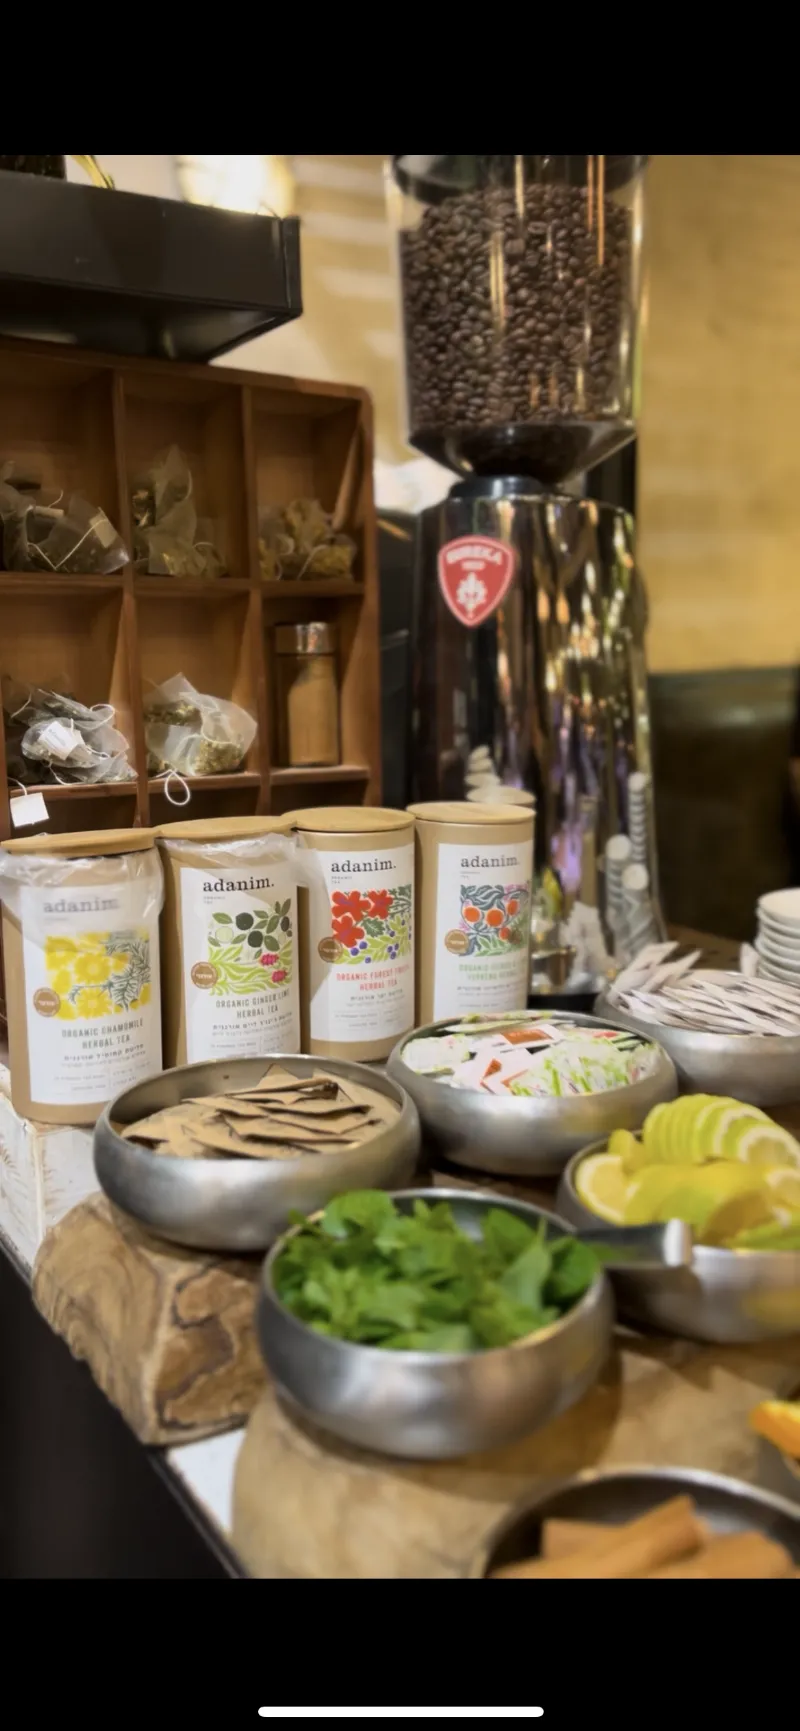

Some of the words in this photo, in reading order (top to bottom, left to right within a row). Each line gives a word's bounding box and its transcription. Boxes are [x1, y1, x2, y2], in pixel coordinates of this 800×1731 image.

[331, 858, 397, 872] adanim.
[203, 876, 275, 892] adanim.
[336, 973, 368, 981] ORGANIC
[216, 998, 249, 1008] ORGANIC
[253, 994, 276, 1005] GINGER
[237, 1009, 264, 1019] HERBAL
[268, 1004, 278, 1013] TEA
[62, 1028, 98, 1038] ORGANIC
[101, 1018, 144, 1034] CHAMOMILE
[82, 1038, 113, 1049] HERBAL
[117, 1034, 130, 1044] TEA
